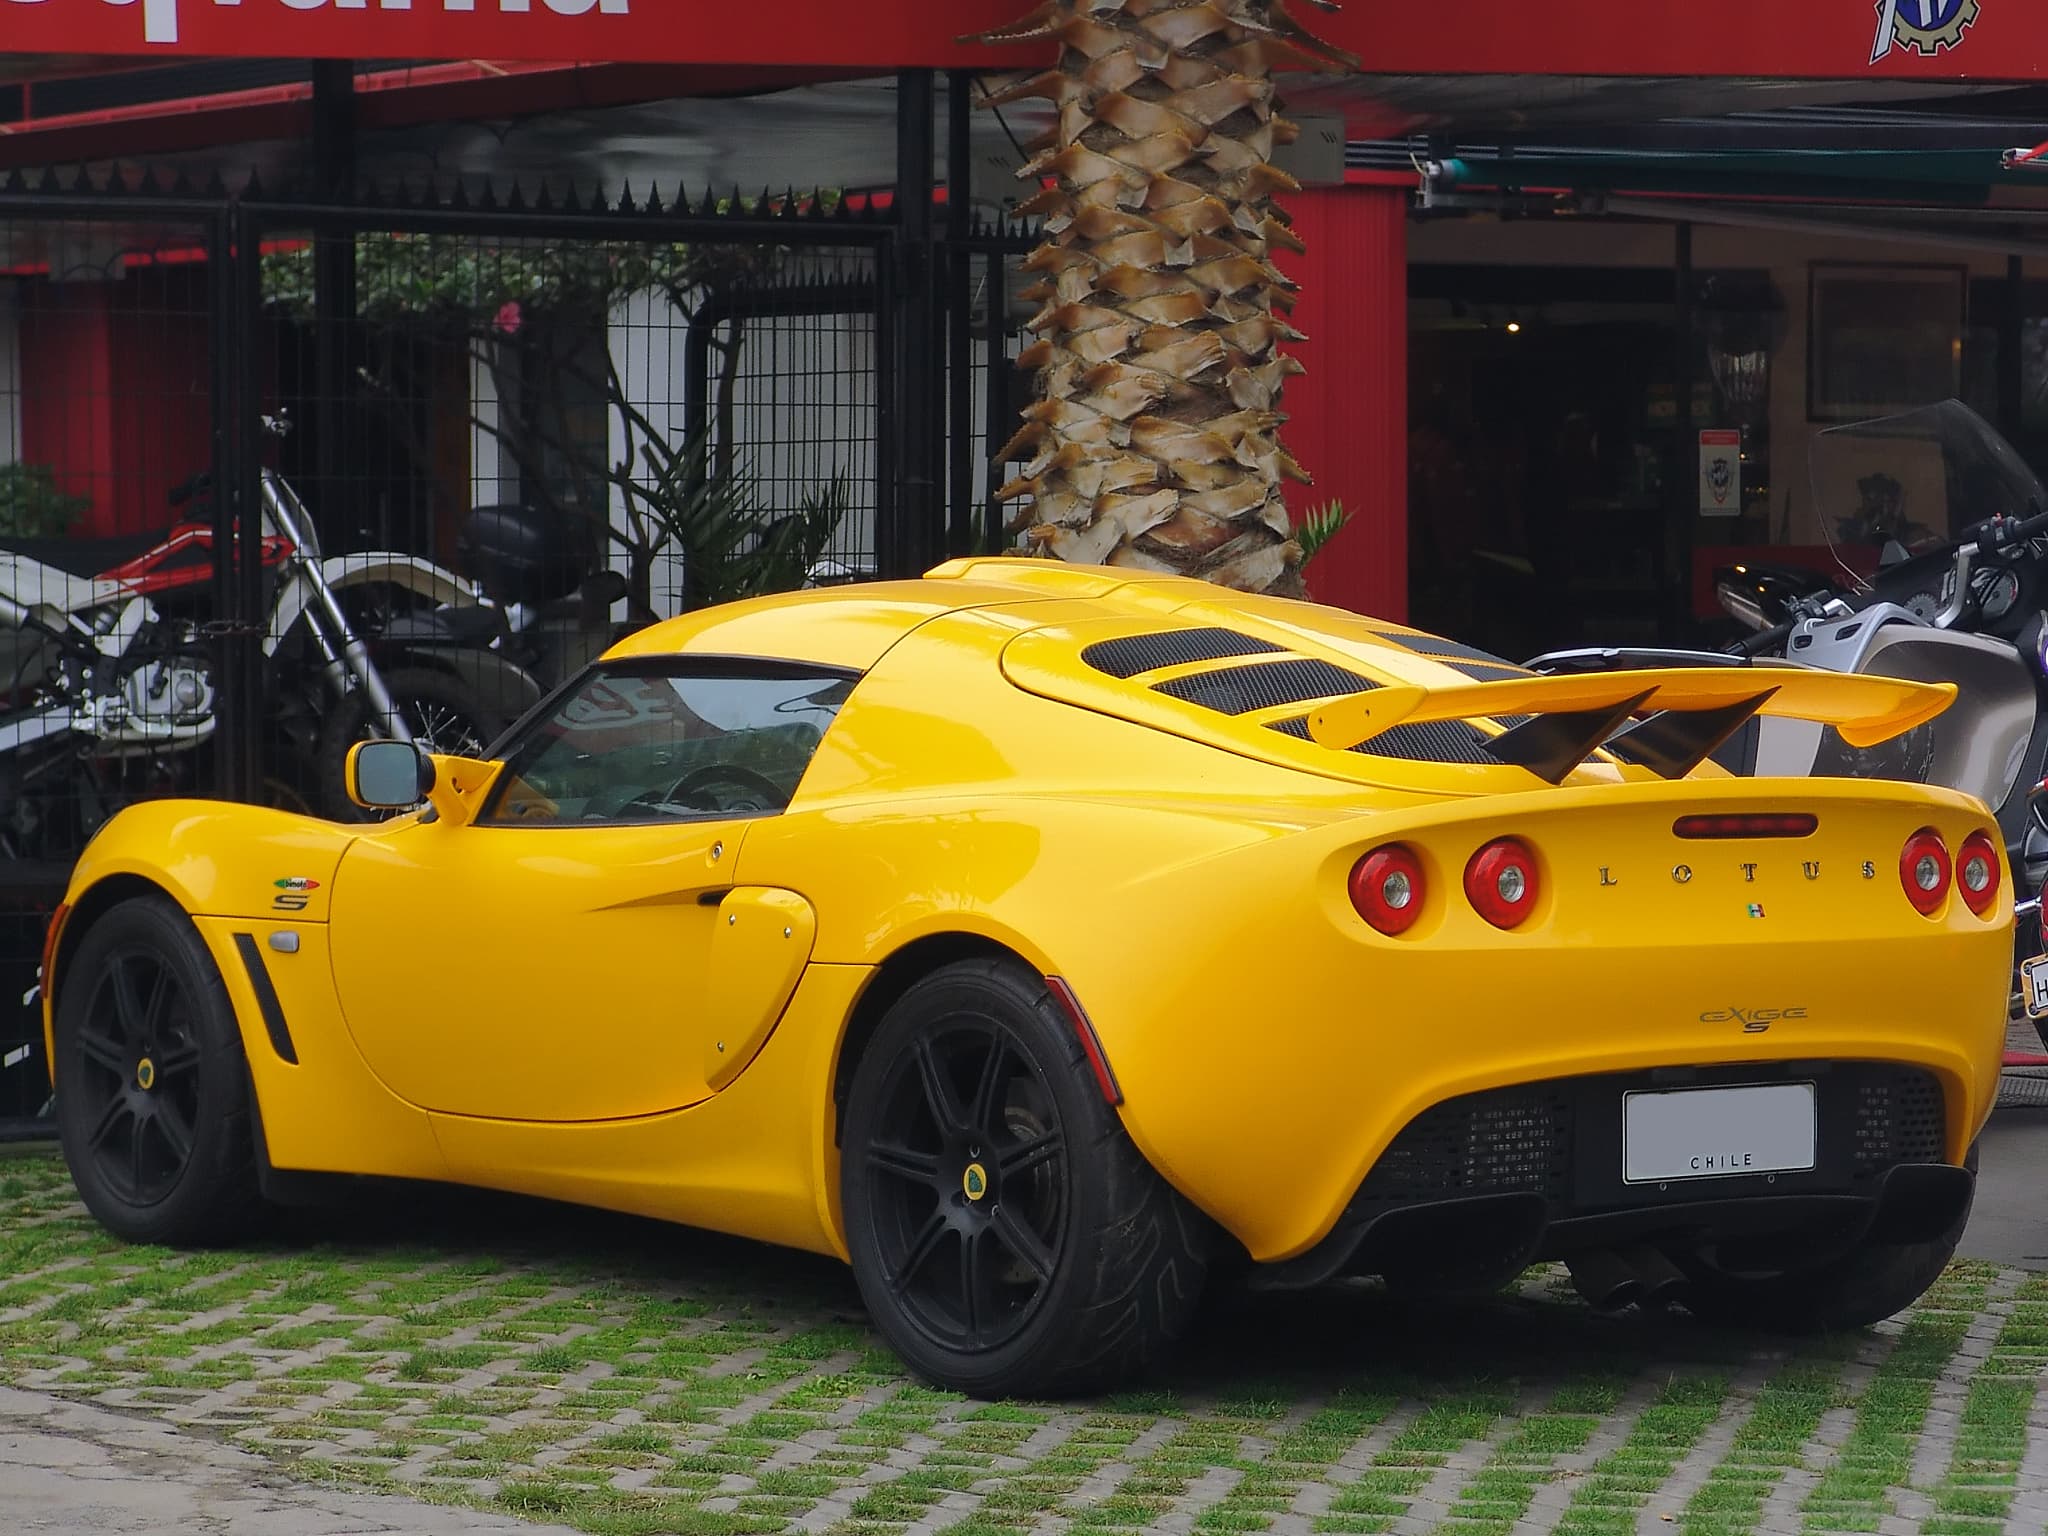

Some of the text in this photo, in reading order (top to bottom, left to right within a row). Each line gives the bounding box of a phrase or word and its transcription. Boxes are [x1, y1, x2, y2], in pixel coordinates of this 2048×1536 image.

[1598, 861, 1875, 886] LOTUS
[271, 895, 308, 911] S
[1699, 1007, 1808, 1024] EXIGE
[1742, 1021, 1771, 1034] S
[1690, 1153, 1752, 1169] CHILE
